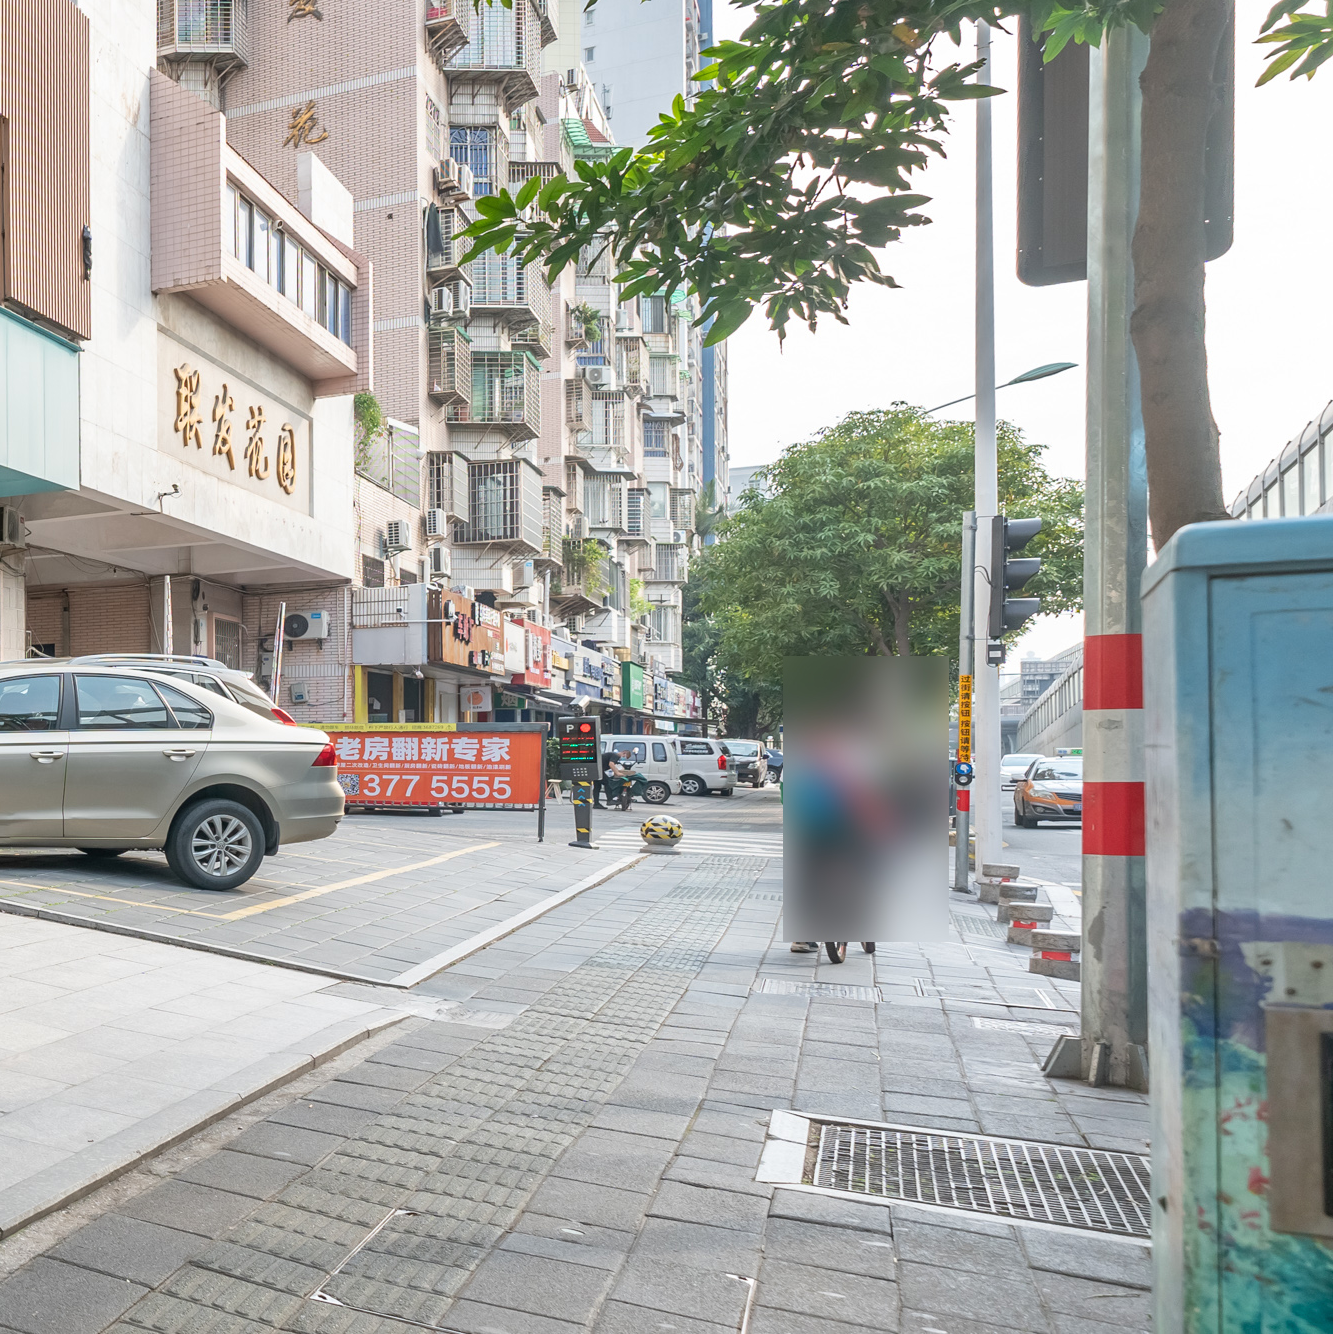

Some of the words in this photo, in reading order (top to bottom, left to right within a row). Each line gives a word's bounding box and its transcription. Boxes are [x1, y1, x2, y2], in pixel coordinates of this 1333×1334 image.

[960, 675, 971, 717] 过街请按钮
[335, 736, 511, 762] 老房翻新专家
[960, 719, 971, 762] 按钮请等待
[363, 774, 420, 797] 377
[430, 775, 512, 799] 5555
